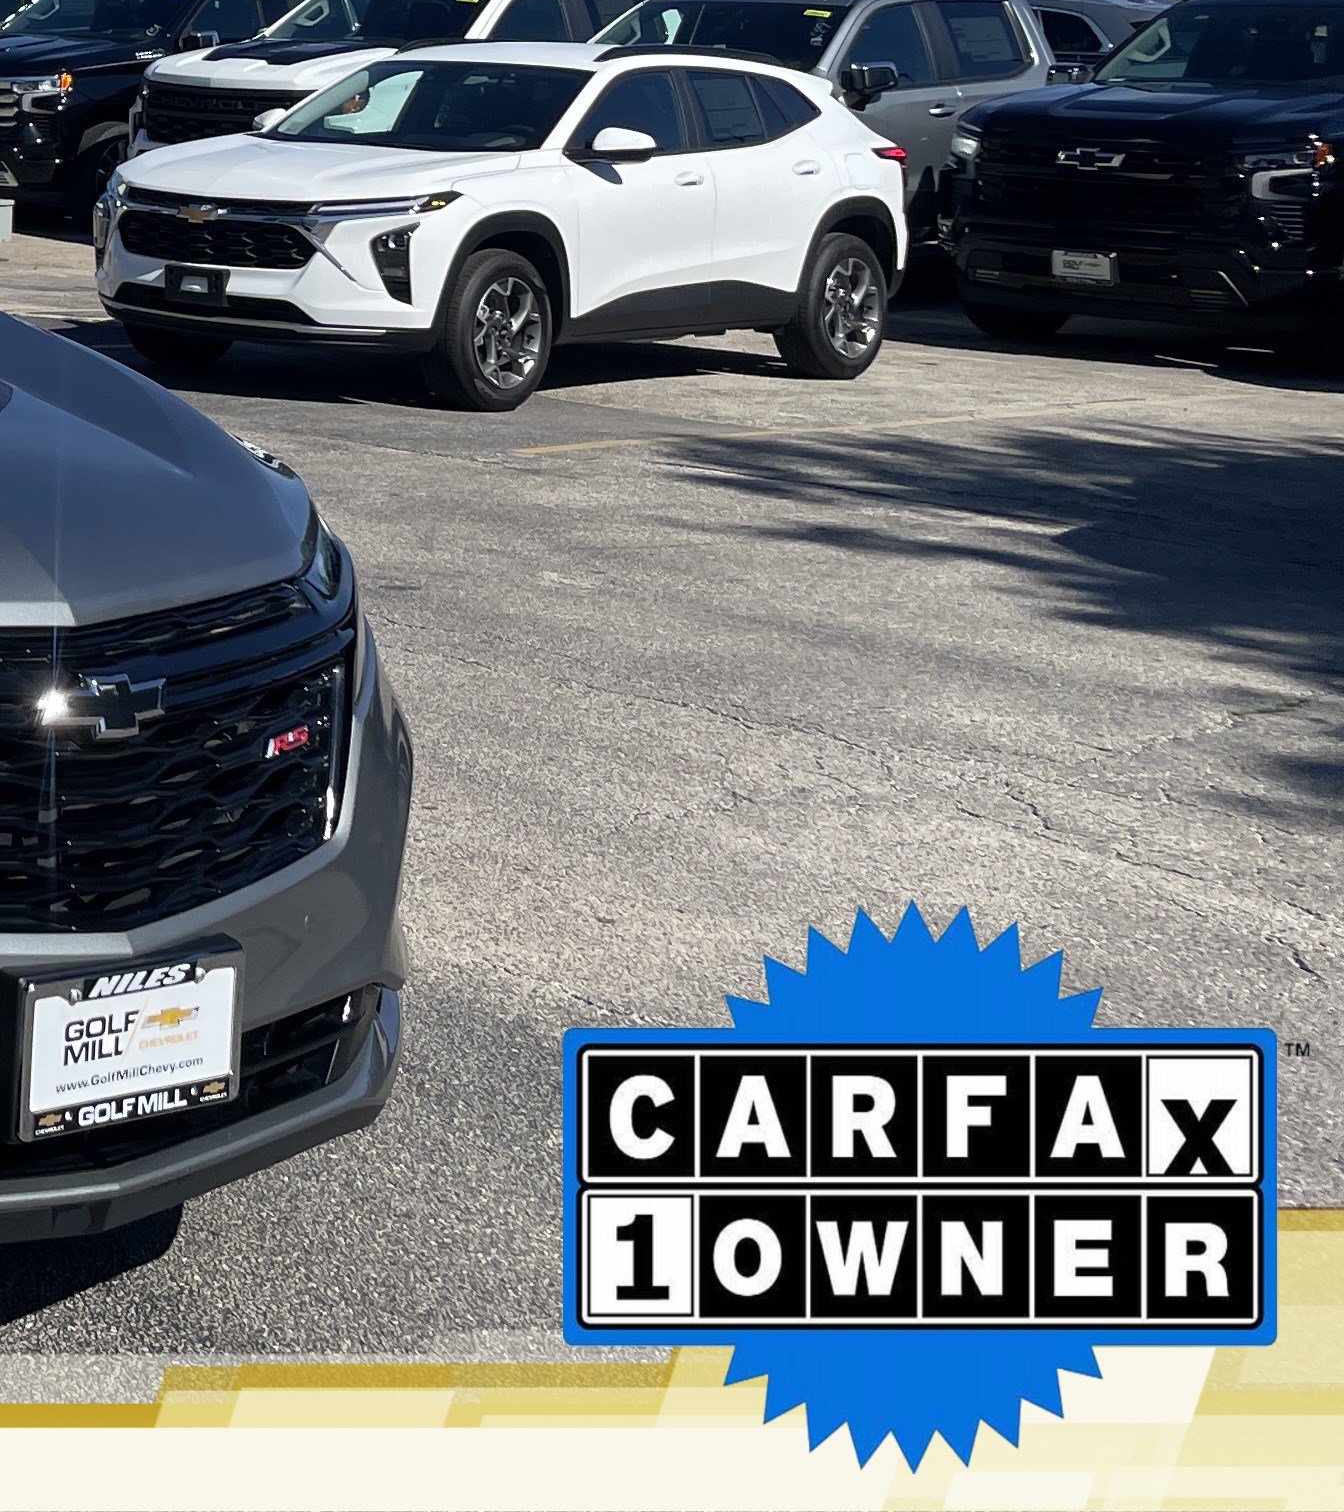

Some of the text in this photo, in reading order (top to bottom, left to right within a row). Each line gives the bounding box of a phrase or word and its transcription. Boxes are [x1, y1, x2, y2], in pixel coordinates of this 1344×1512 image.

[88, 963, 191, 998] NILES
[64, 1009, 140, 1043] GOLF
[138, 1030, 199, 1050] CHEVROLET
[63, 1035, 123, 1066] MILL
[55, 1056, 204, 1093] www.GolfMillChevy.com
[78, 1087, 188, 1127] GOLF MILL
